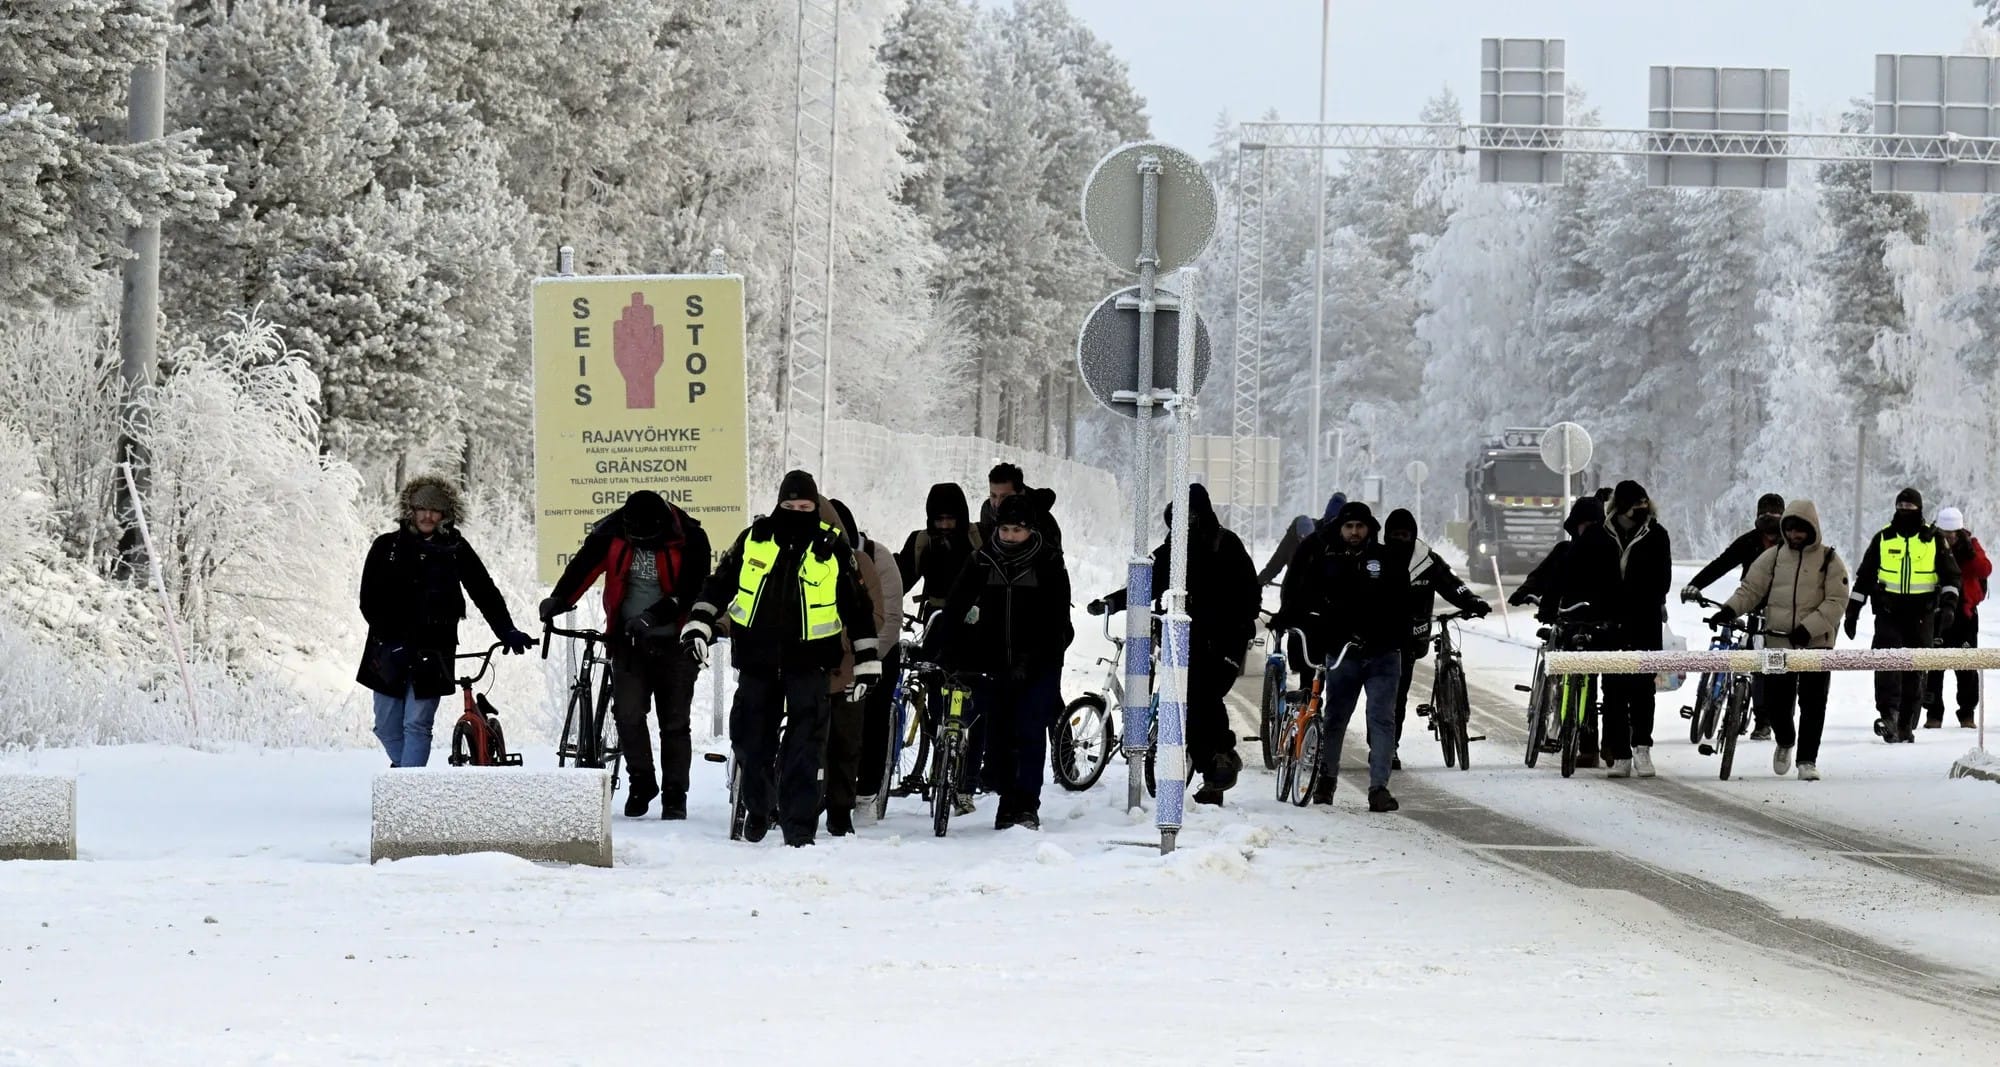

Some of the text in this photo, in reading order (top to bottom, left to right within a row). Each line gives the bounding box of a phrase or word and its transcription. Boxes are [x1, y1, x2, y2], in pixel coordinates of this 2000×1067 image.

[572, 297, 593, 407] SEIS
[686, 294, 707, 404] STOP
[582, 426, 701, 444] RAJAVYÖHYKE
[596, 457, 687, 473] GRÄNSZON
[592, 489, 693, 505] GREONE
[574, 508, 595, 516] OHNE
[702, 505, 741, 513] VERBOTEN
